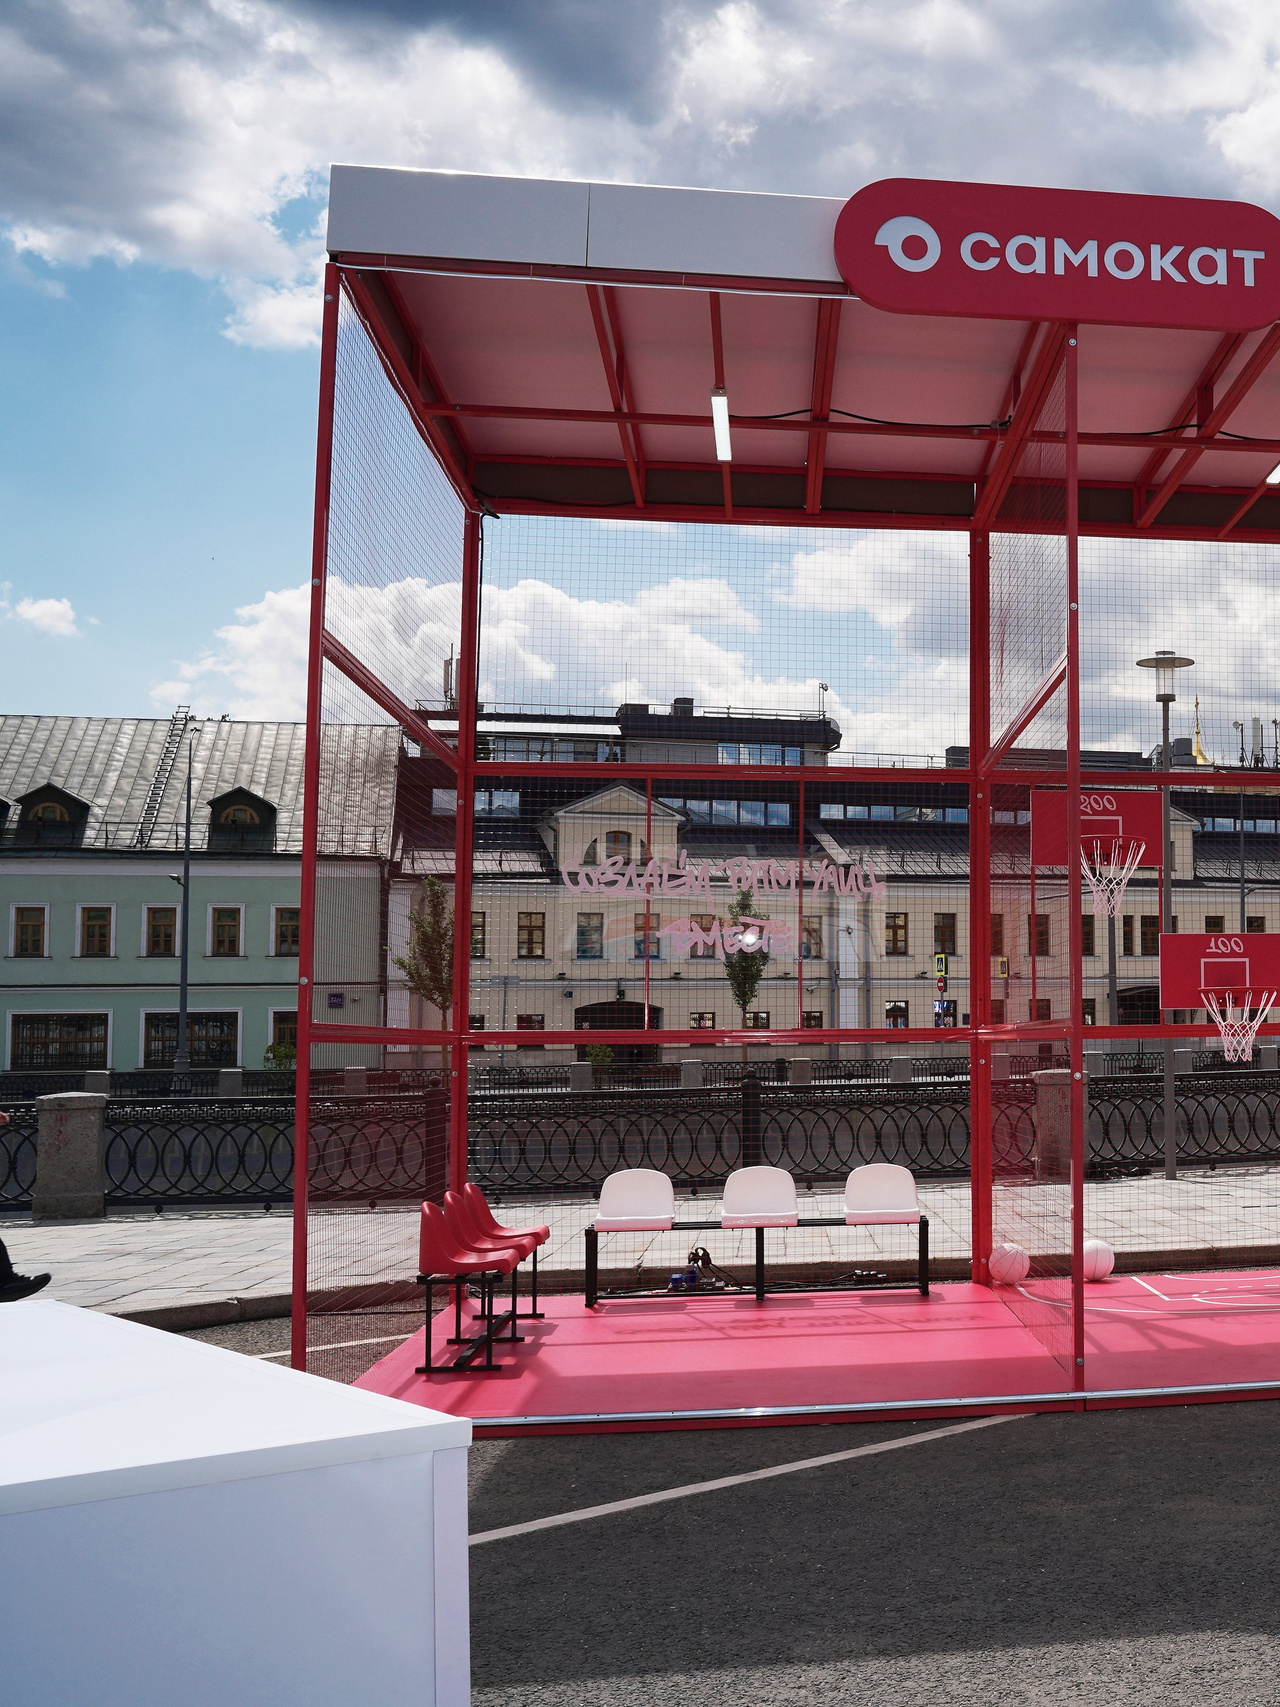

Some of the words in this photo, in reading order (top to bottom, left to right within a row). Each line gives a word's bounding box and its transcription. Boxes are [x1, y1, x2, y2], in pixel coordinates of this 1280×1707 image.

[960, 231, 1266, 287] самокат
[1080, 794, 1117, 814] 200
[1205, 937, 1244, 954] 100
